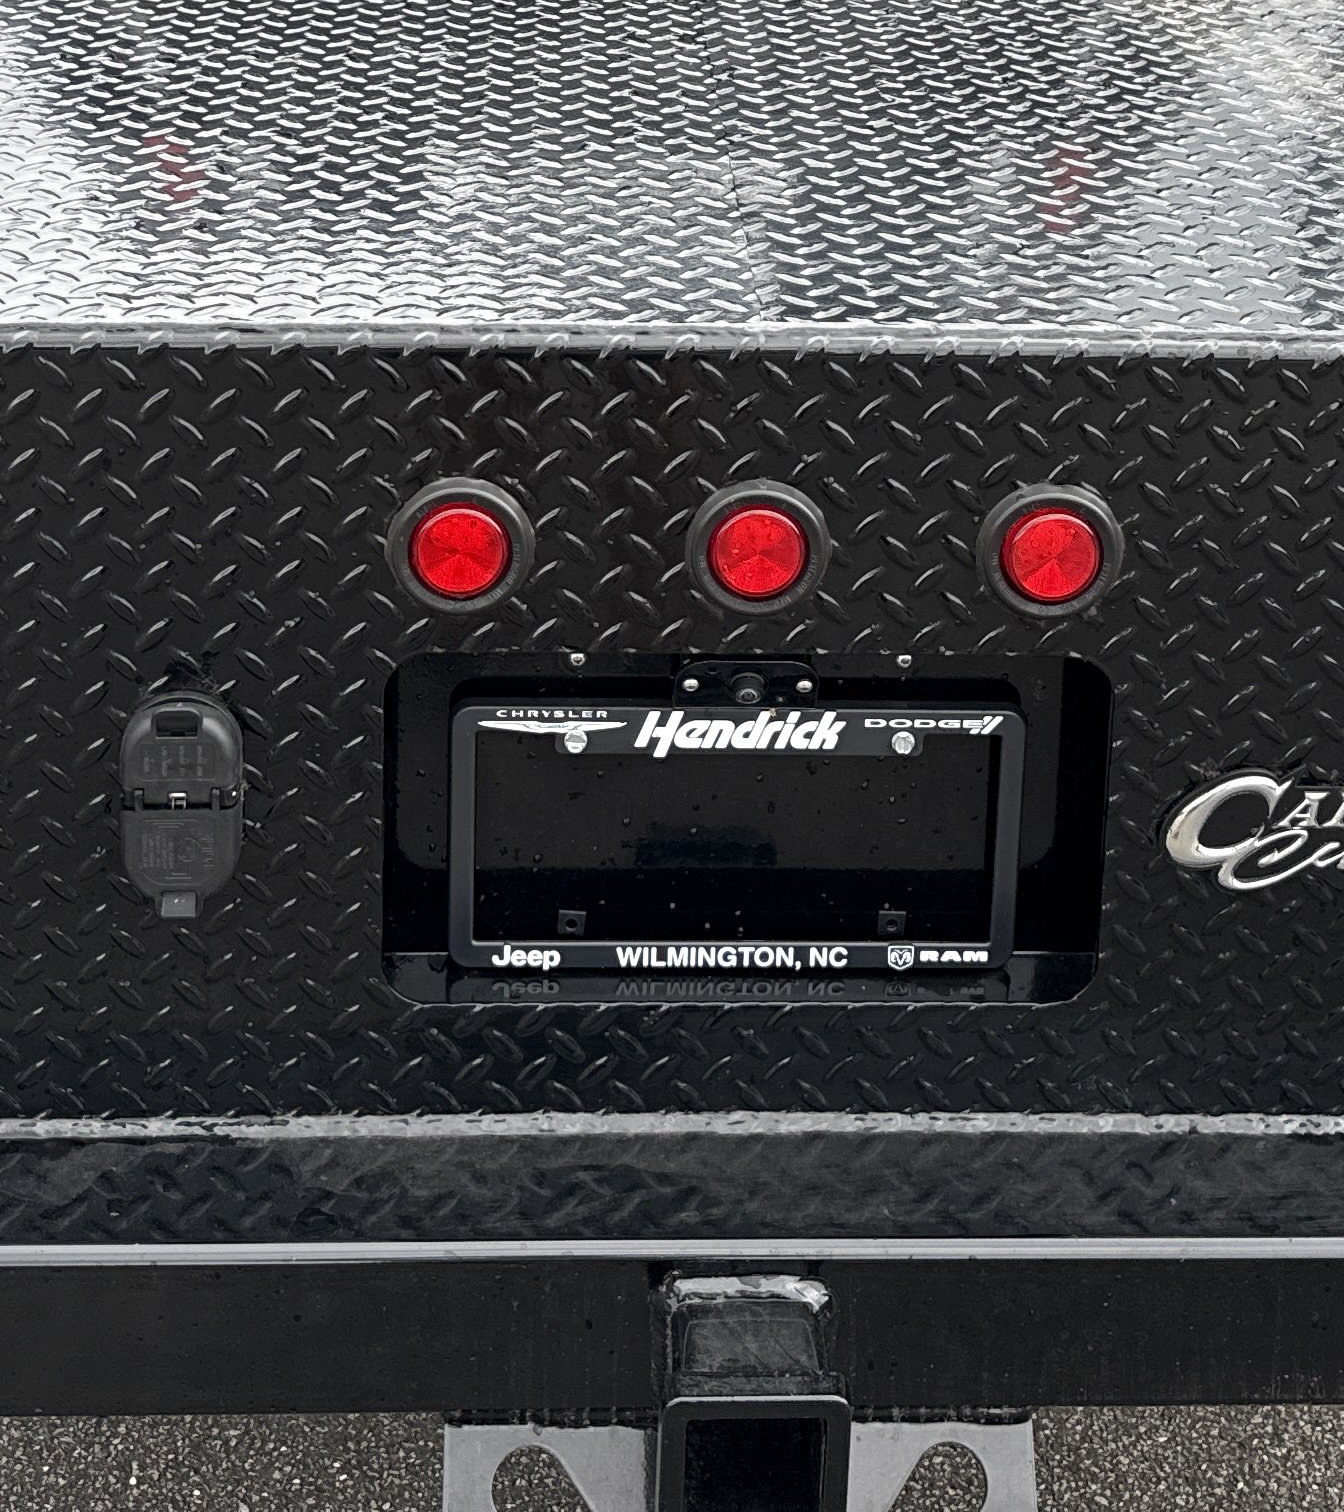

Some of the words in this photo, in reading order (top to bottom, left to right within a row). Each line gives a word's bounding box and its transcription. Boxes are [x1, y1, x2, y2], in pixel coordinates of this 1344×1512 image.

[496, 709, 608, 719] CHRYSLER
[864, 718, 984, 729] DODGE
[633, 710, 847, 758] Hendrick
[492, 944, 561, 971] Jeep
[615, 946, 802, 971] WILMINGTON,
[809, 946, 849, 967] NC
[919, 950, 989, 963] RAM
